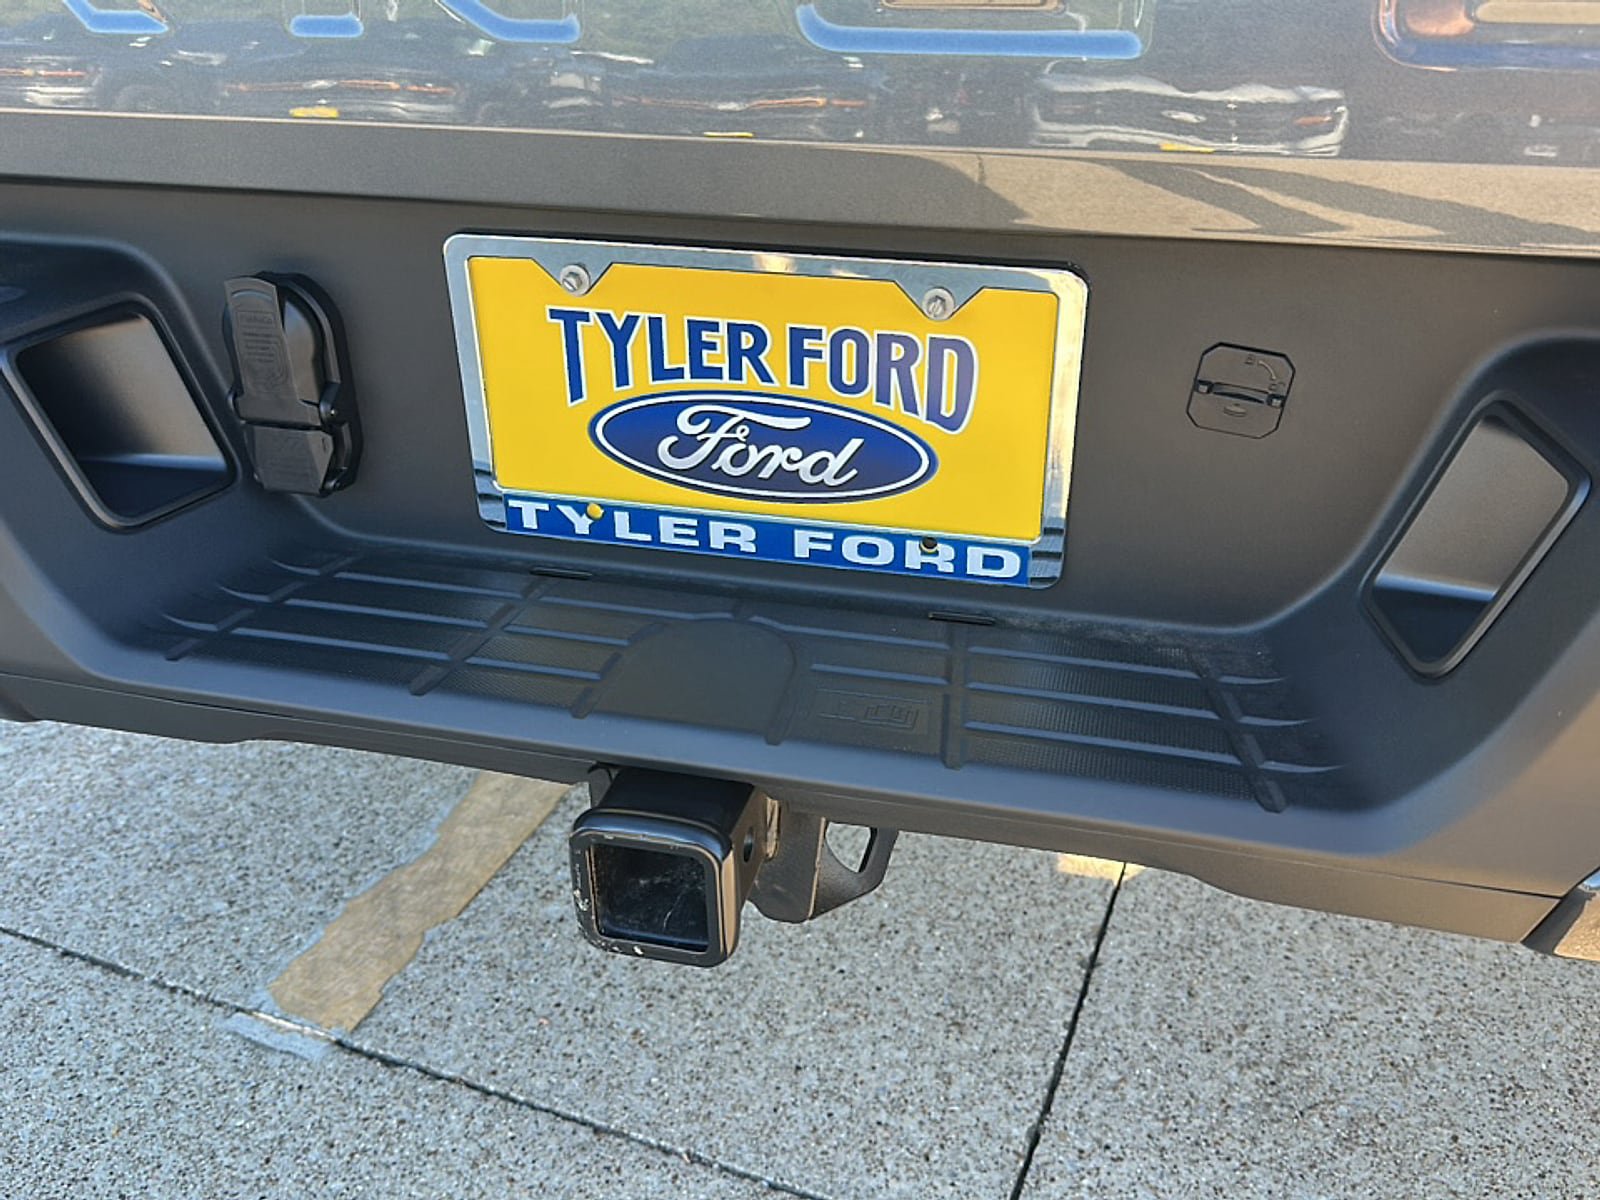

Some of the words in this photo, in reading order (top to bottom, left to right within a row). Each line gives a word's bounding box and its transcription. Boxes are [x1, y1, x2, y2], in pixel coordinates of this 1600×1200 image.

[546, 305, 775, 405] TYLER
[786, 326, 978, 434] FORD
[657, 404, 865, 487] Ford
[507, 499, 757, 553] TYLER
[794, 530, 1022, 578] FORD
